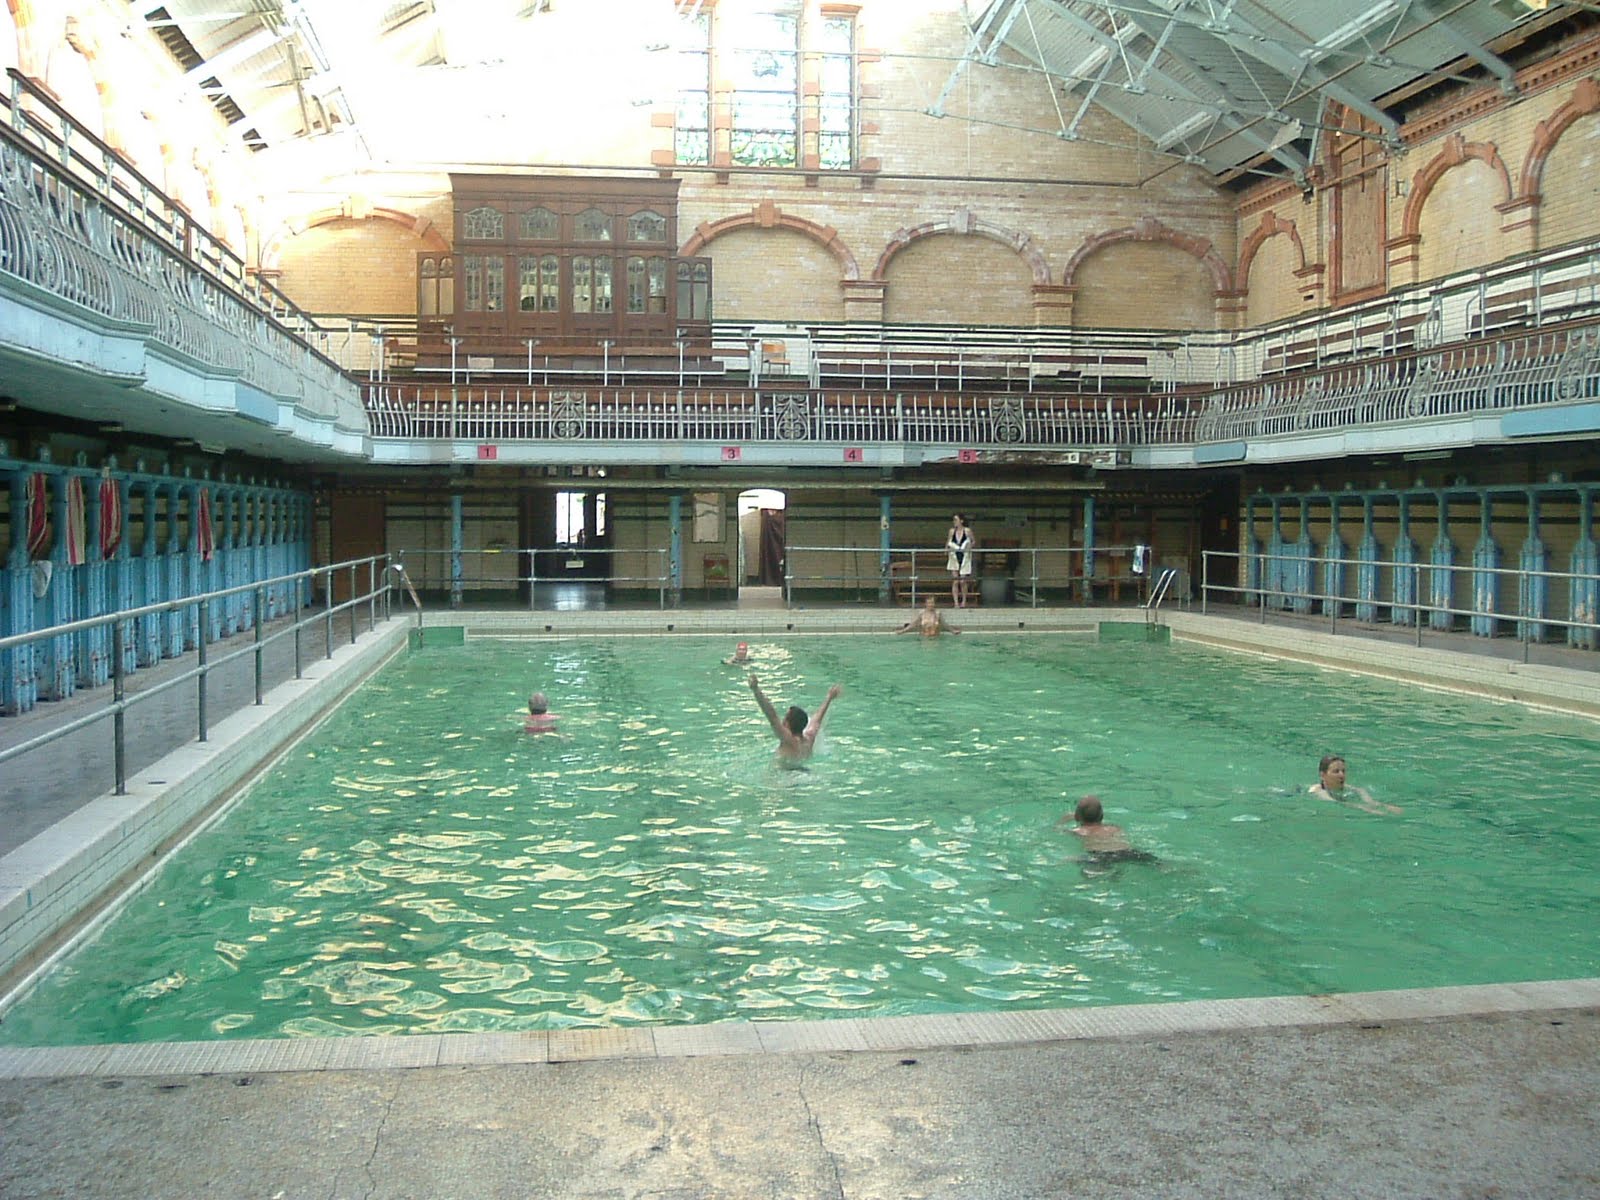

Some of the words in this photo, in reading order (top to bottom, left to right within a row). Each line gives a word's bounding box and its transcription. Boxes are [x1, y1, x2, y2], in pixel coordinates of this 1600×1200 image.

[728, 448, 735, 459] 3
[848, 449, 857, 460] 4
[963, 450, 971, 461] 5
